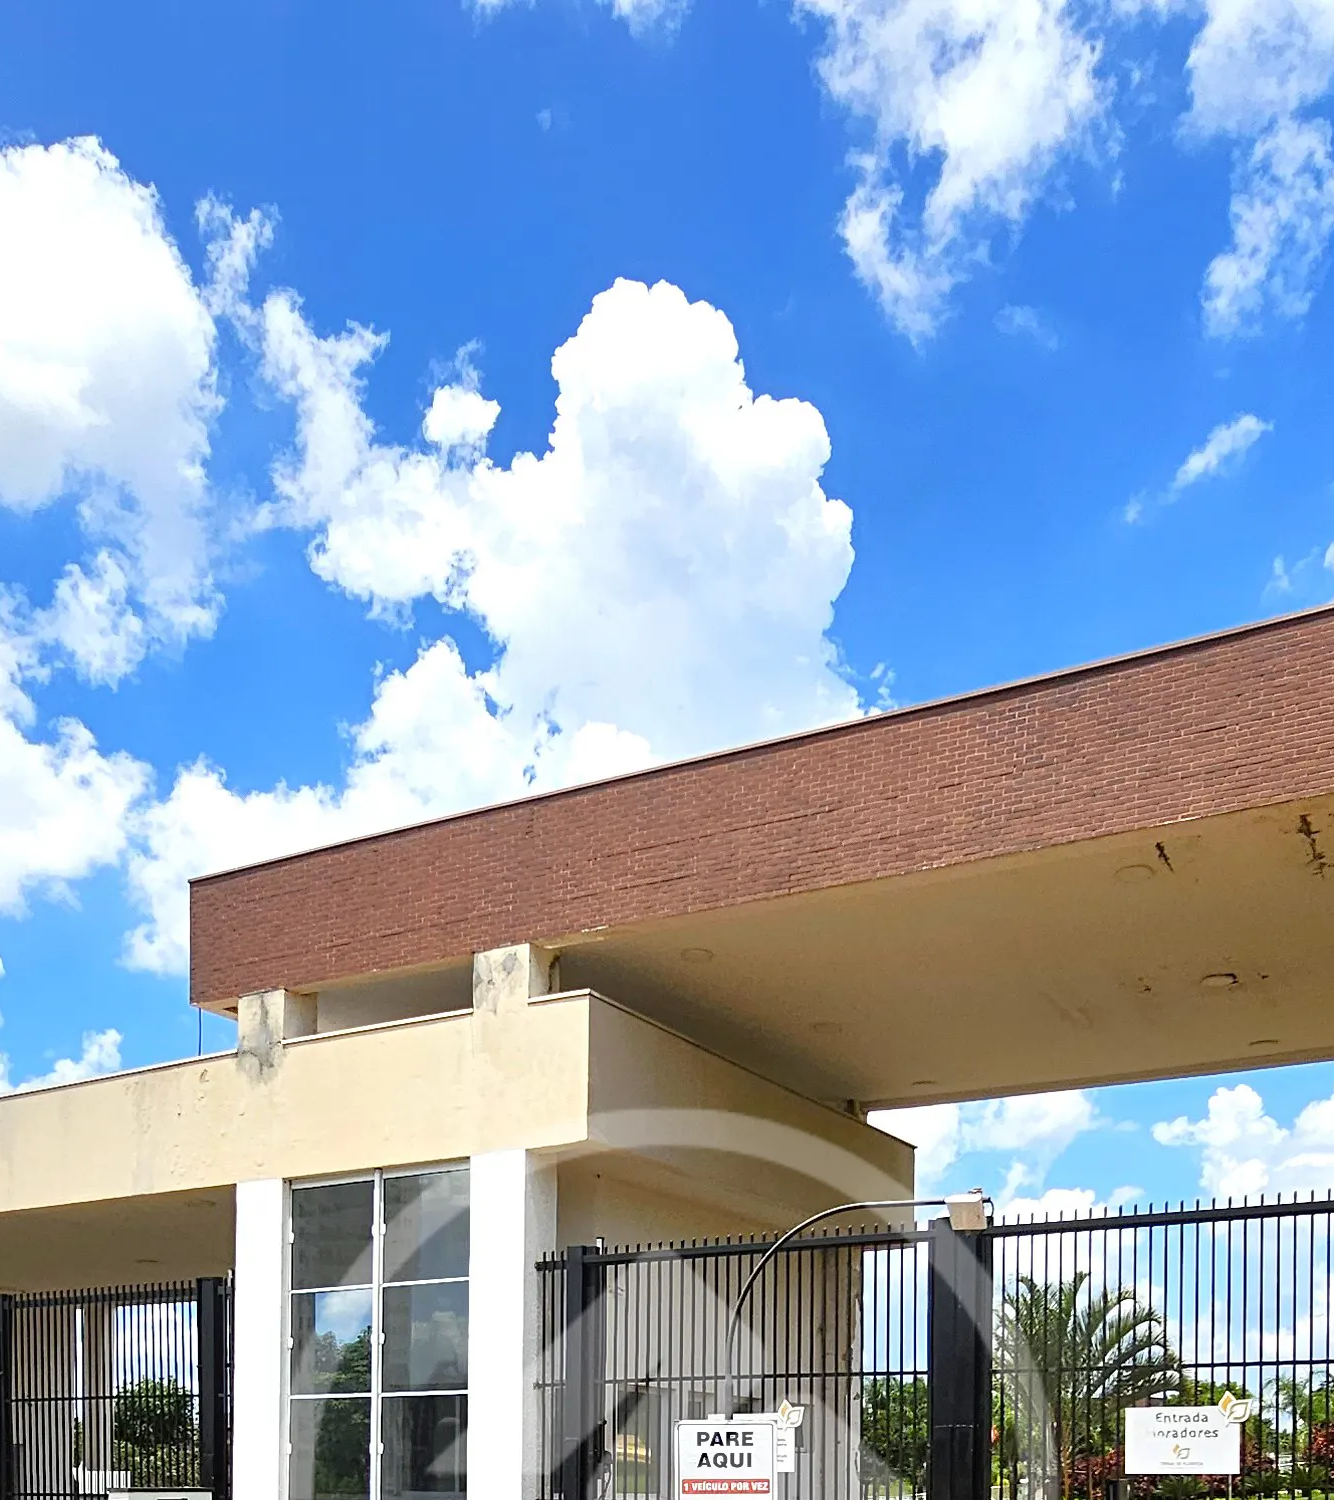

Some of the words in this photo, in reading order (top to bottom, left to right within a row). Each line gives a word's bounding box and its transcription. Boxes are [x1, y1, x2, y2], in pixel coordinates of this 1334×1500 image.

[1156, 1412, 1209, 1423] Entrada
[697, 1431, 754, 1447] PARE
[697, 1452, 752, 1468] AQUI
[683, 1482, 689, 1491] 1
[691, 1481, 728, 1491] VEÍCULO
[730, 1481, 749, 1491] POR
[751, 1481, 769, 1491] VEZ
